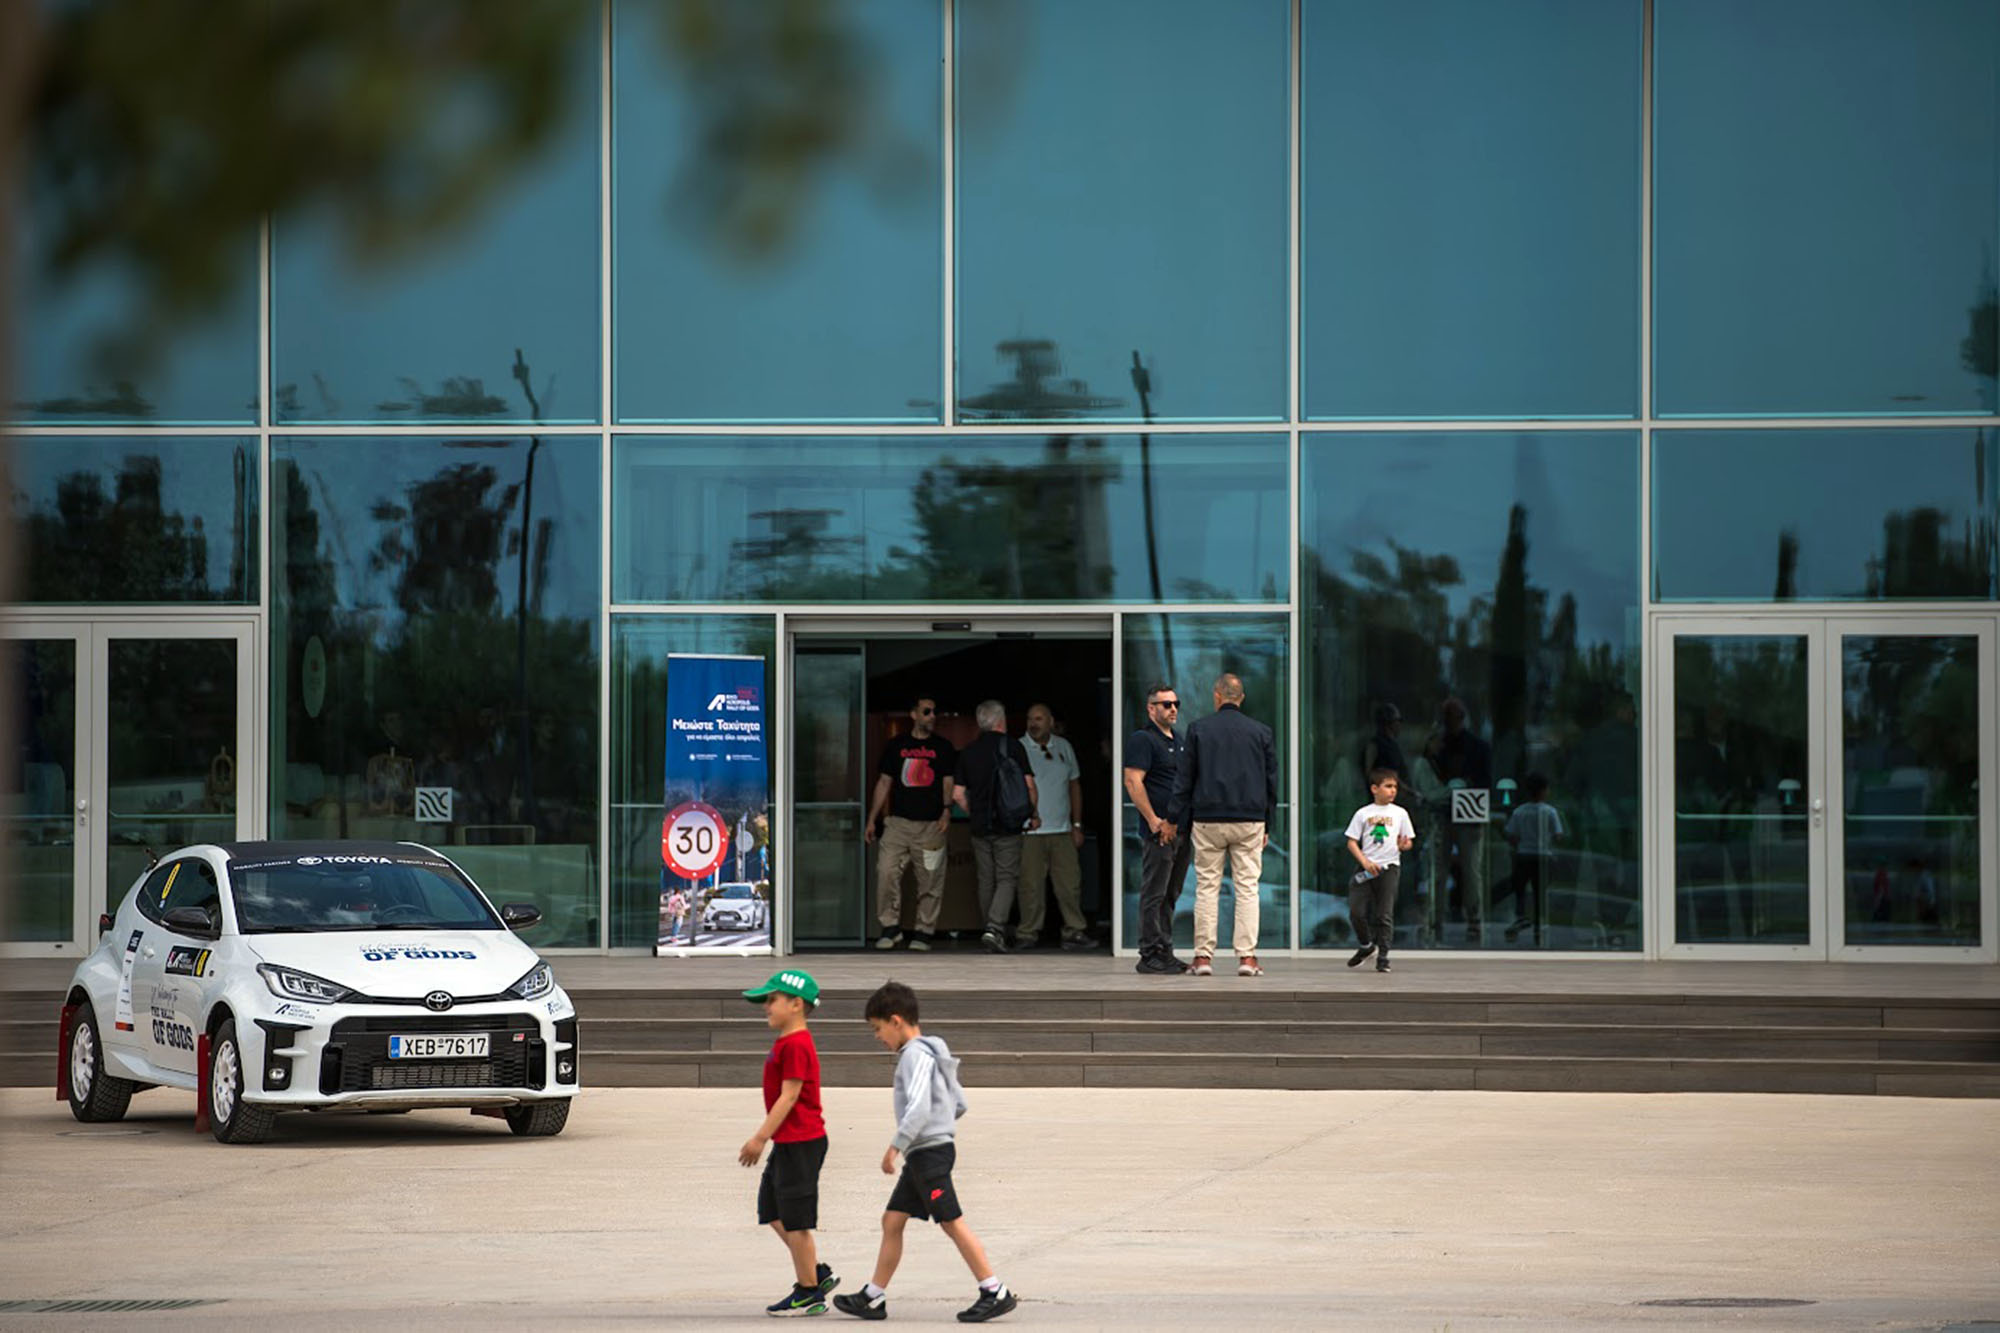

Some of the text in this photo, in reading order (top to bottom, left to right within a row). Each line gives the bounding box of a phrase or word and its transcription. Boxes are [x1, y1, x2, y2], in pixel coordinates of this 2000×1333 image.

[672, 718, 760, 733] Μειώστε Ταχύτητα
[676, 826, 712, 854] 30
[323, 856, 392, 865] TOYOTA
[363, 950, 477, 961] OF GODS
[152, 1018, 194, 1052] OF GODS
